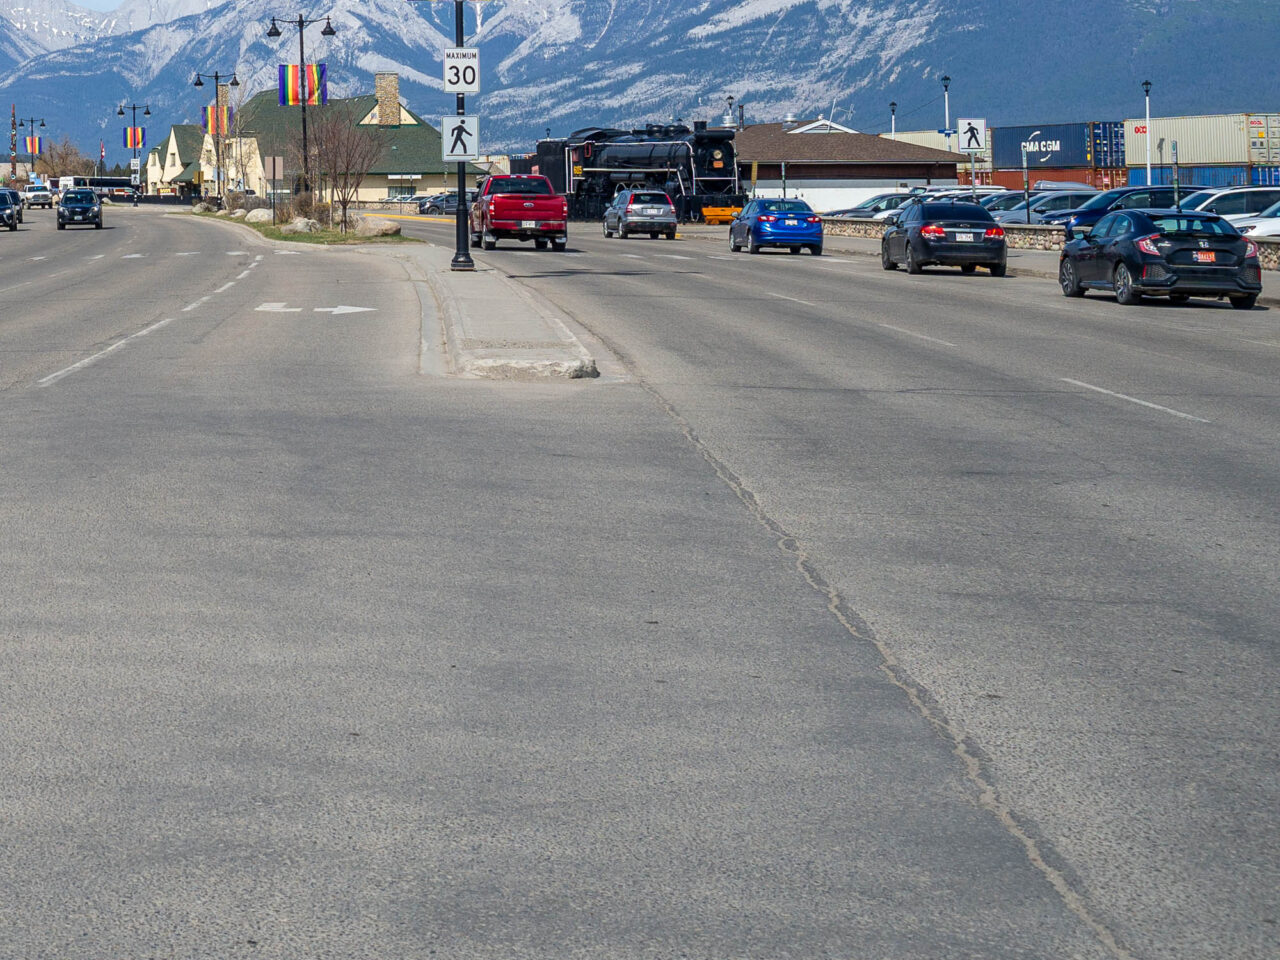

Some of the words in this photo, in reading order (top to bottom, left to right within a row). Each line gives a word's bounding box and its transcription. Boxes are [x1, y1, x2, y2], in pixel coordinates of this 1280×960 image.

[448, 65, 475, 85] 30
[1021, 141, 1039, 152] CMA
[1040, 140, 1060, 152] CGM
